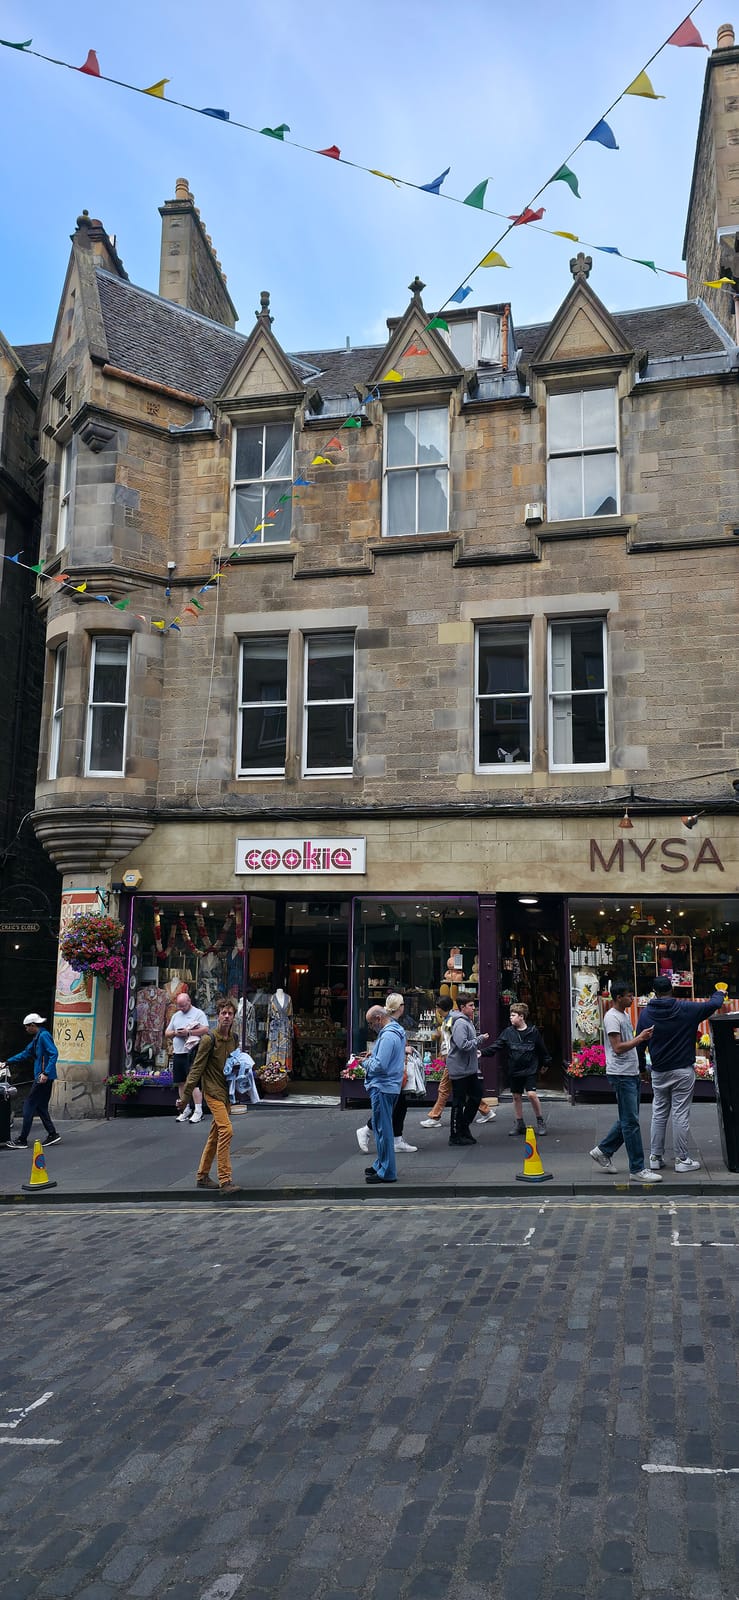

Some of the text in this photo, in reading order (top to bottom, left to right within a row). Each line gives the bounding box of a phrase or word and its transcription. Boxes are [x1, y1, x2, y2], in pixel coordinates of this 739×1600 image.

[245, 841, 352, 870] cookie
[590, 837, 725, 873] MYSA
[54, 1028, 85, 1041] YSA
